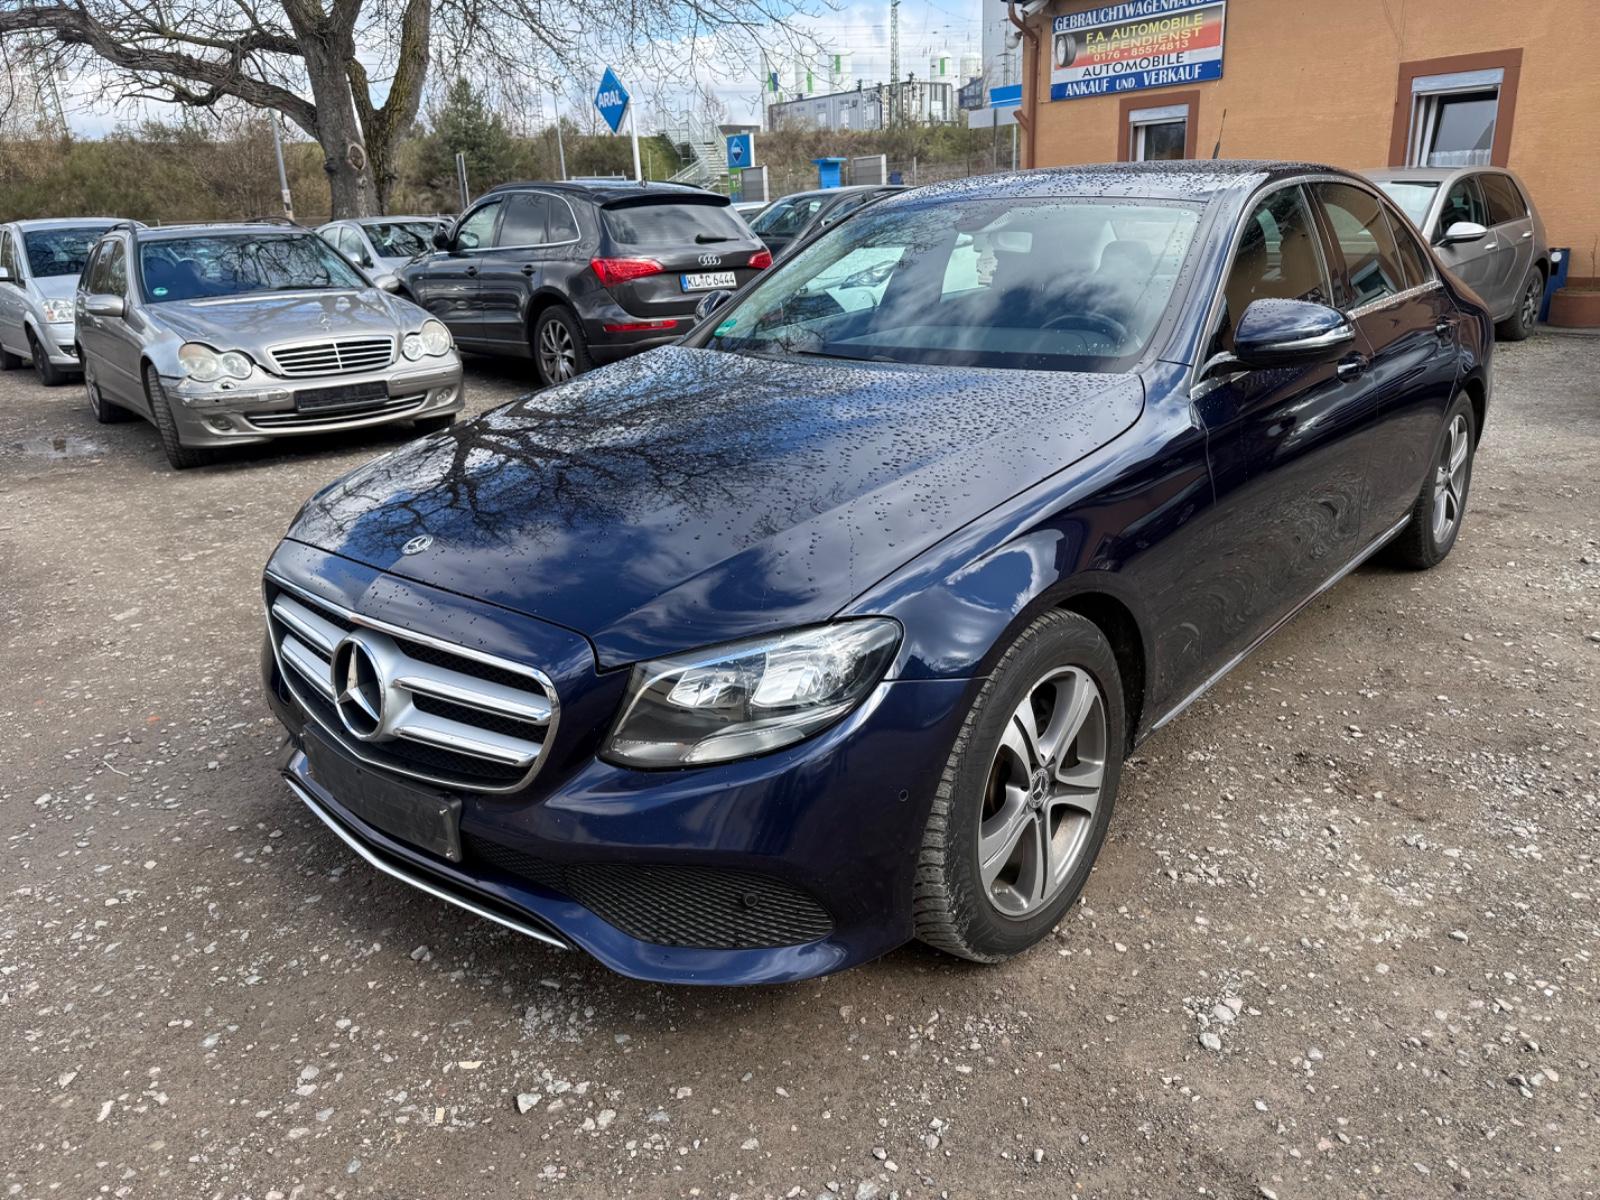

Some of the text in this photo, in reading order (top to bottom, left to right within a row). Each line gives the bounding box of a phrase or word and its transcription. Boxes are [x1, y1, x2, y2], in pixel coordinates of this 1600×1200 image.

[1086, 13, 1203, 44] F.A. AUTOMOBILE
[1087, 27, 1203, 54] REIFENDIENST
[1094, 51, 1120, 61] 0176
[1131, 40, 1189, 56] 85574813
[1081, 52, 1184, 78] AUTOMOBILE
[1065, 78, 1110, 96] ANKAUF
[1143, 64, 1203, 86] VERKAUF
[598, 90, 623, 108] ARAL
[687, 276, 700, 287] KL
[713, 273, 735, 286] 6444
